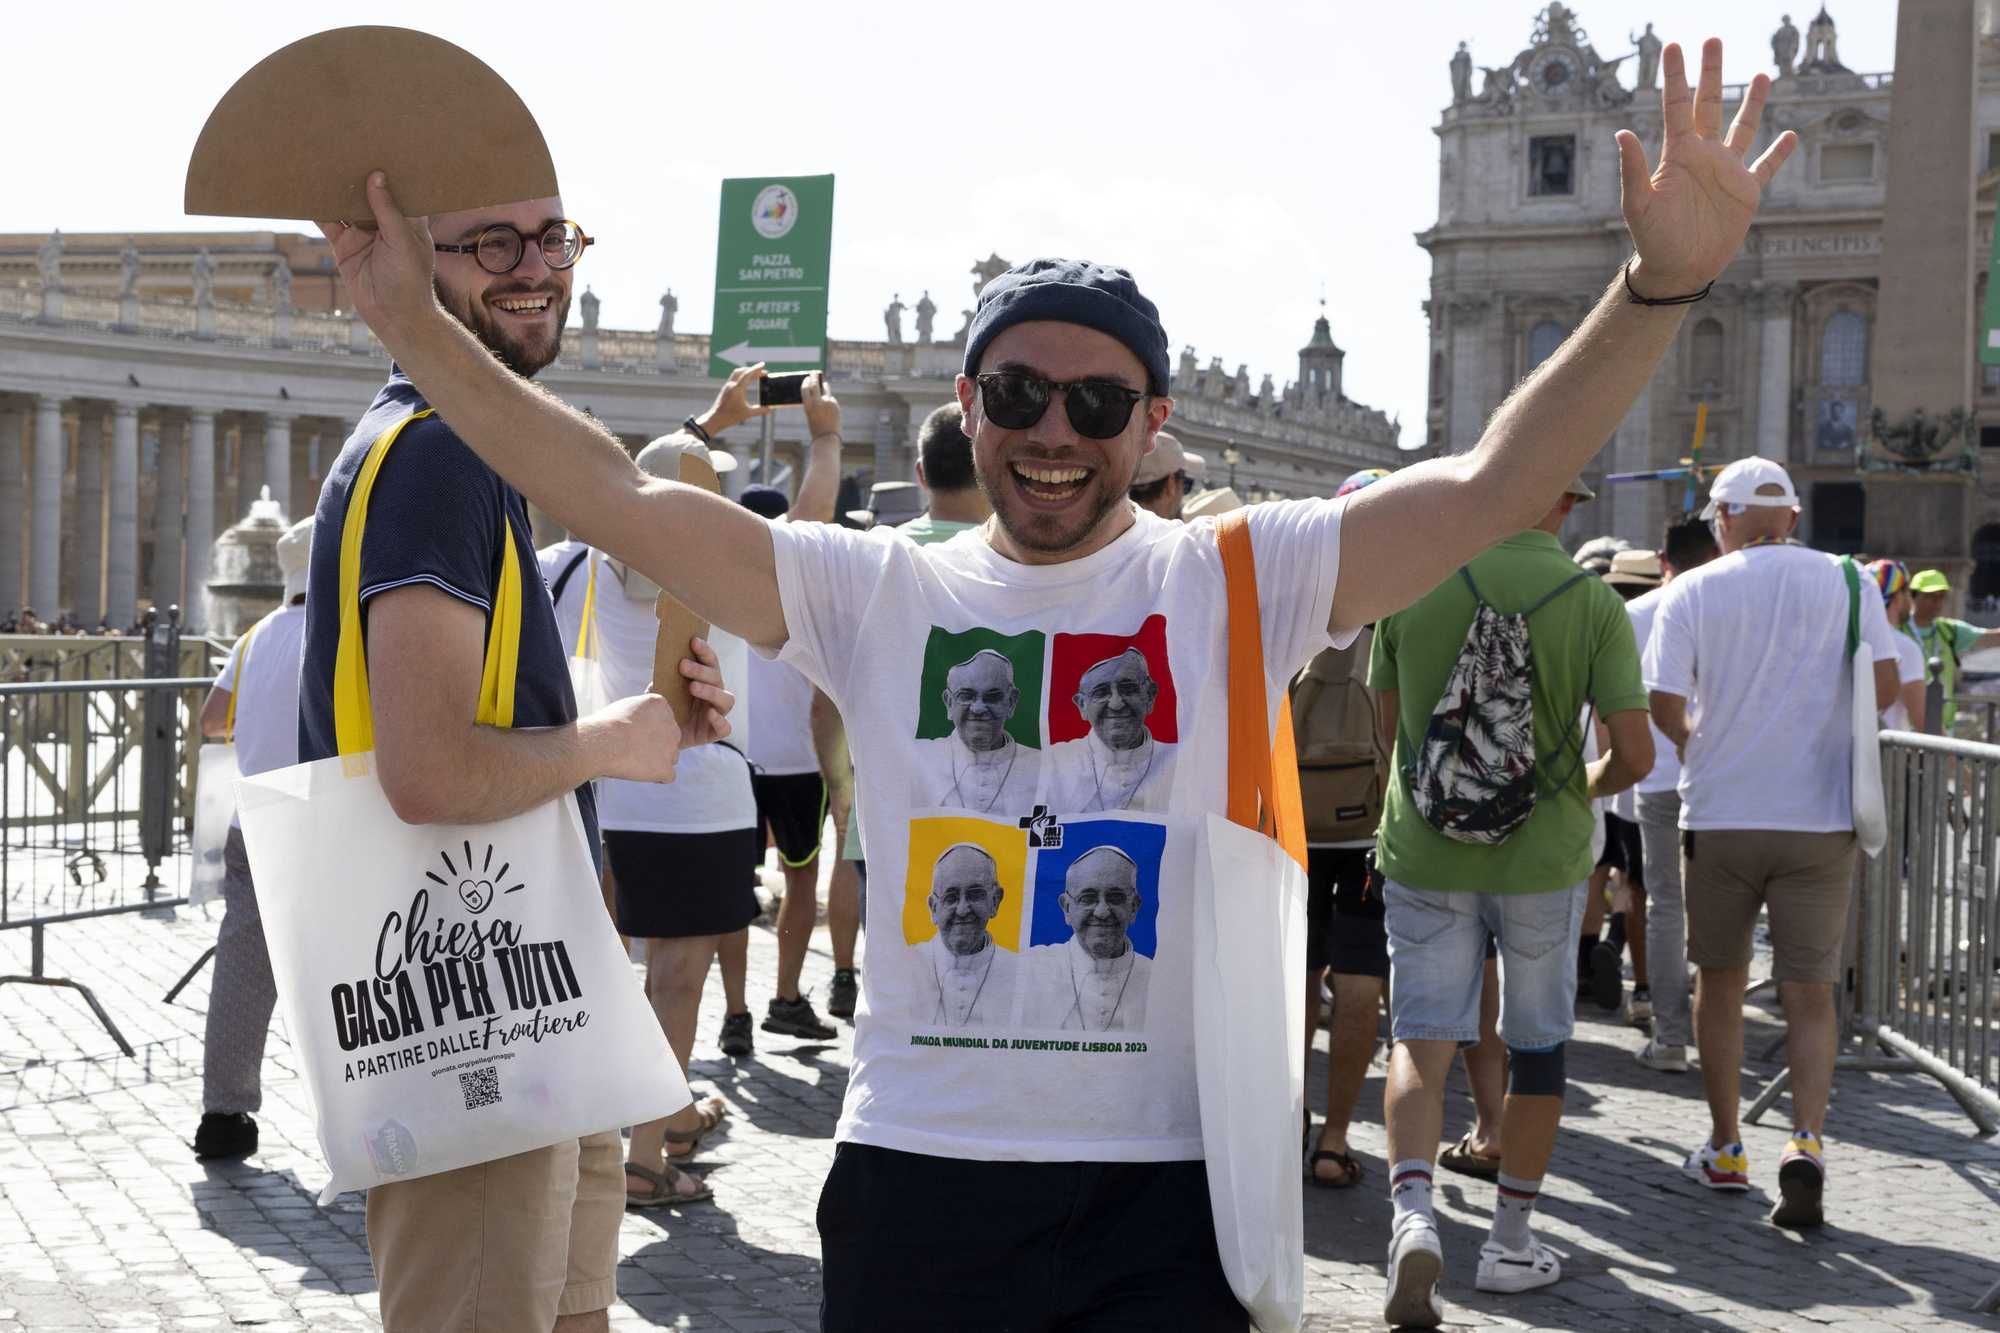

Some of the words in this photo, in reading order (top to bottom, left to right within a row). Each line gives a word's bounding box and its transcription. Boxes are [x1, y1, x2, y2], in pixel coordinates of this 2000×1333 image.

[752, 254, 791, 266] PIAZZA
[738, 268, 761, 281] SAN
[763, 267, 803, 280] PIETRO
[738, 301, 753, 314] ST.
[755, 300, 800, 313] PETER'S
[747, 318, 790, 330] SQUARE
[375, 888, 522, 982] Chiesa
[331, 970, 425, 1052] CASA
[423, 954, 496, 1027] PER
[494, 940, 583, 1011] TUTTI
[344, 1063, 356, 1083] A
[358, 1044, 425, 1080] PARTIRE
[427, 1029, 482, 1061] DALLE
[481, 1008, 591, 1051] Frontiere
[942, 1037, 990, 1049] MUNDIAL
[991, 1038, 1009, 1049] DA
[1010, 1039, 1080, 1051] JUVENTUDE
[1081, 1041, 1123, 1053] LISBOA
